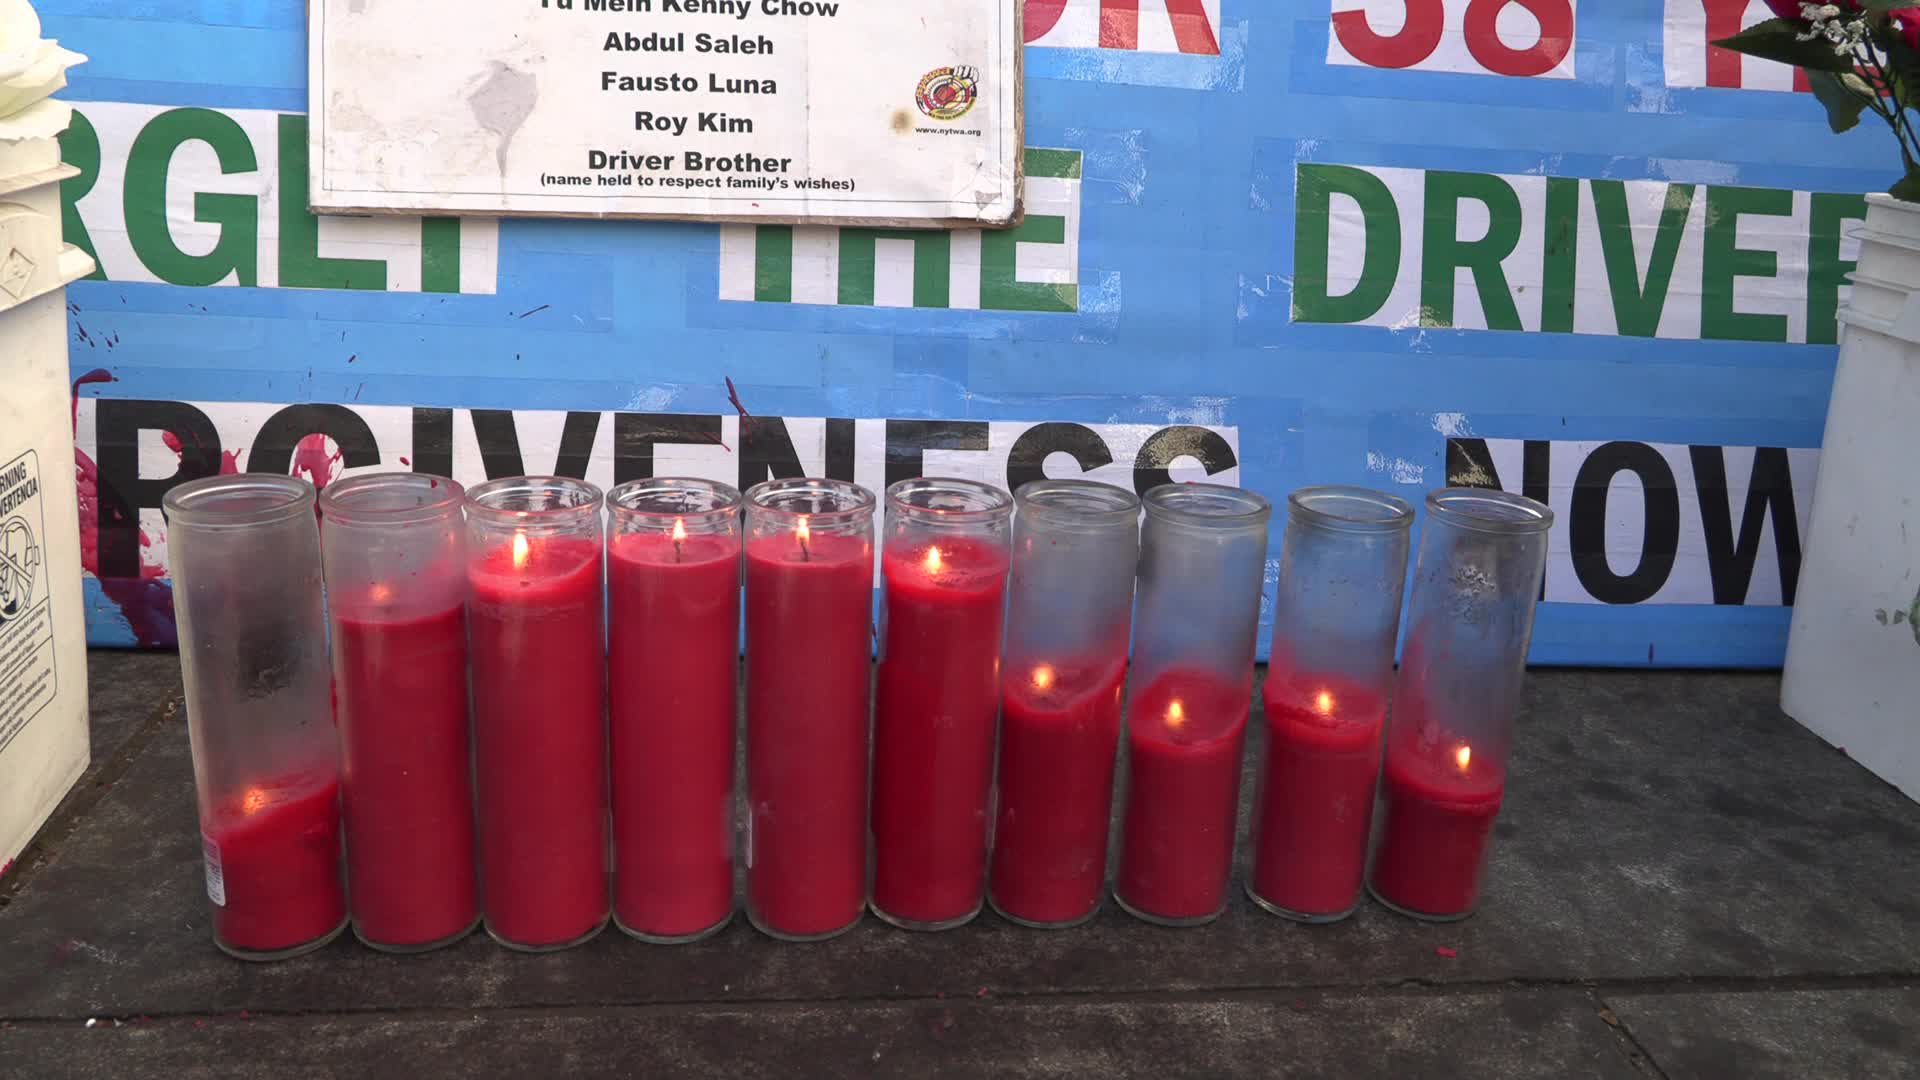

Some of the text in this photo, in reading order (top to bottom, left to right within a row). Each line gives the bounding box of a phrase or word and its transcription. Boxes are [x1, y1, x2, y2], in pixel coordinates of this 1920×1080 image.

[584, 0, 651, 12] Mein
[662, 0, 752, 20] Kenny
[761, 0, 839, 17] Chow
[603, 31, 774, 55] Abdul Saleh
[601, 71, 777, 95] Fausto Luna
[635, 111, 753, 137] Roy Kim
[915, 127, 981, 136] www.nytwa.org
[588, 150, 792, 173] Driver Brother
[540, 173, 855, 193] (name held to respect family’s wishes)
